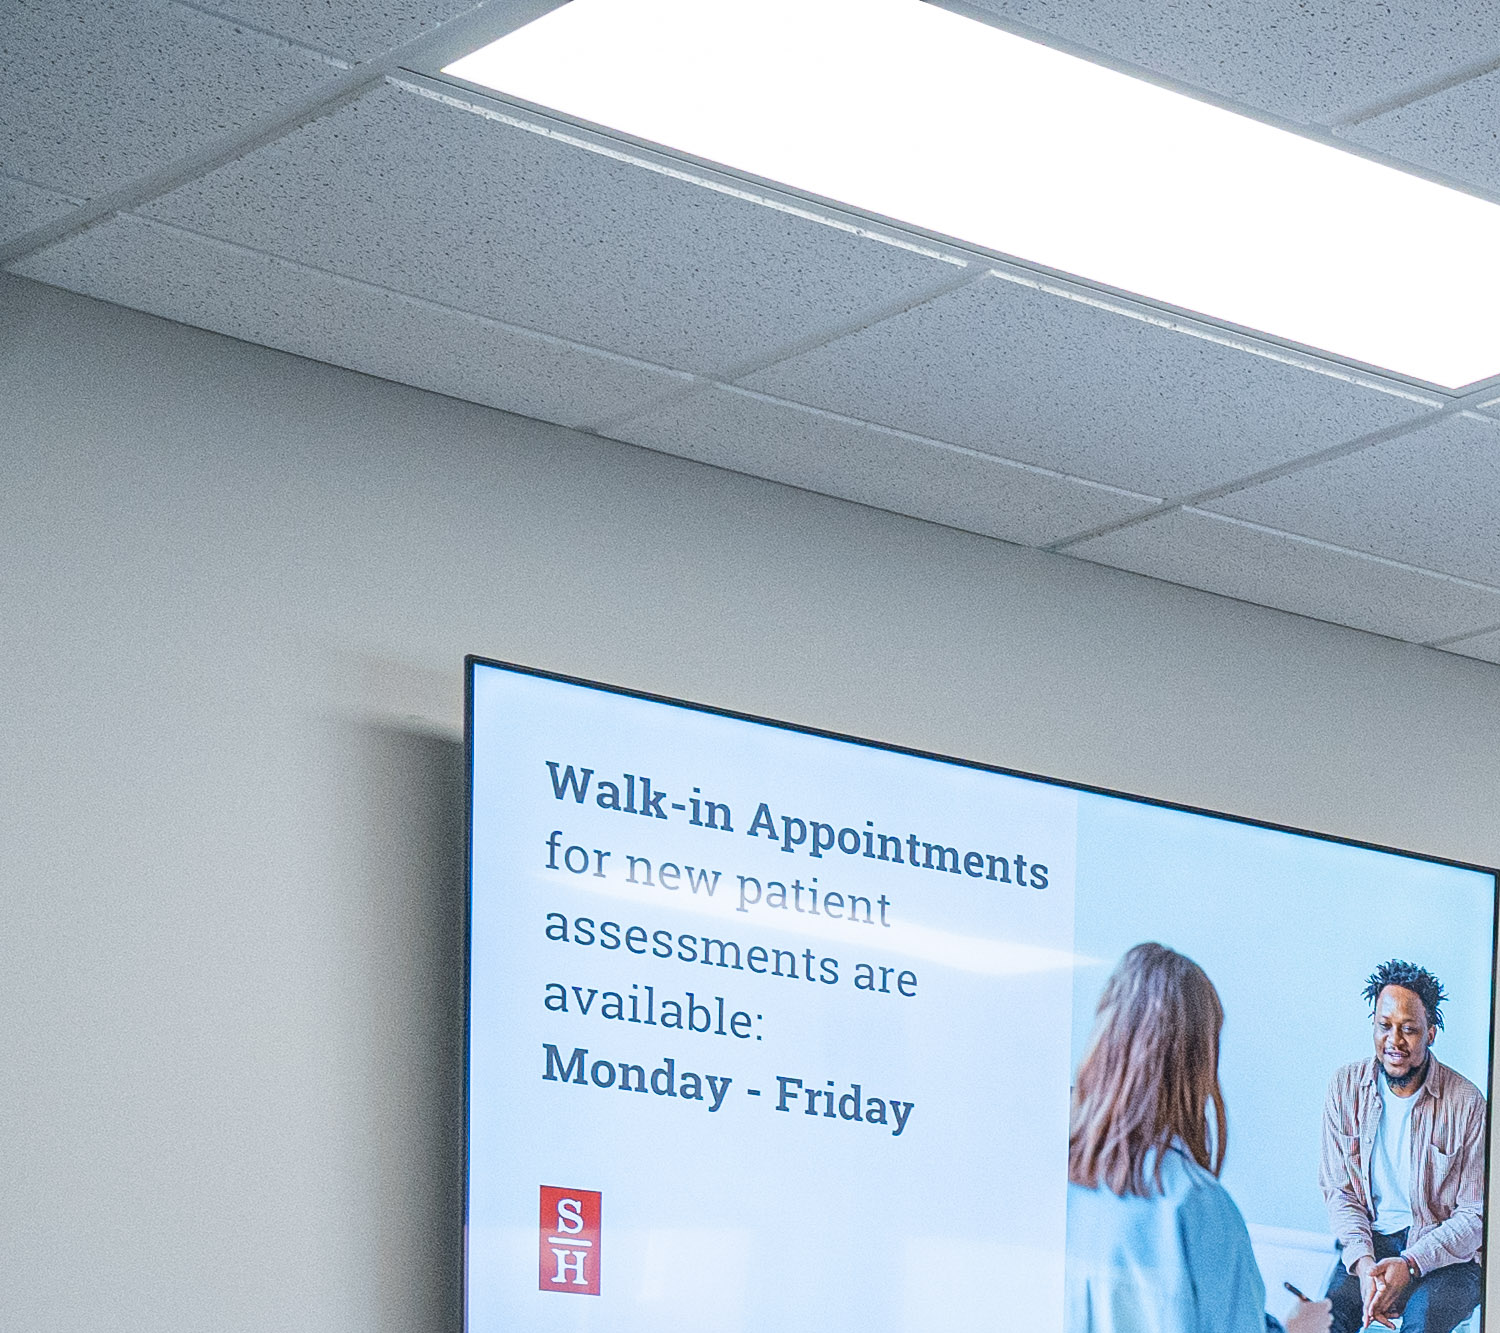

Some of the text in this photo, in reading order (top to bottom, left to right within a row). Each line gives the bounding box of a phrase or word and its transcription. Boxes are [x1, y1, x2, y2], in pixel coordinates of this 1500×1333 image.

[545, 760, 1050, 890] Walk-in Appointments
[545, 830, 891, 927] for new patient
[544, 912, 918, 997] assessments are
[544, 983, 765, 1042] available:
[542, 1043, 734, 1112] Monday
[775, 1076, 915, 1136] Friday
[557, 1198, 583, 1234] S
[550, 1248, 589, 1285] H
